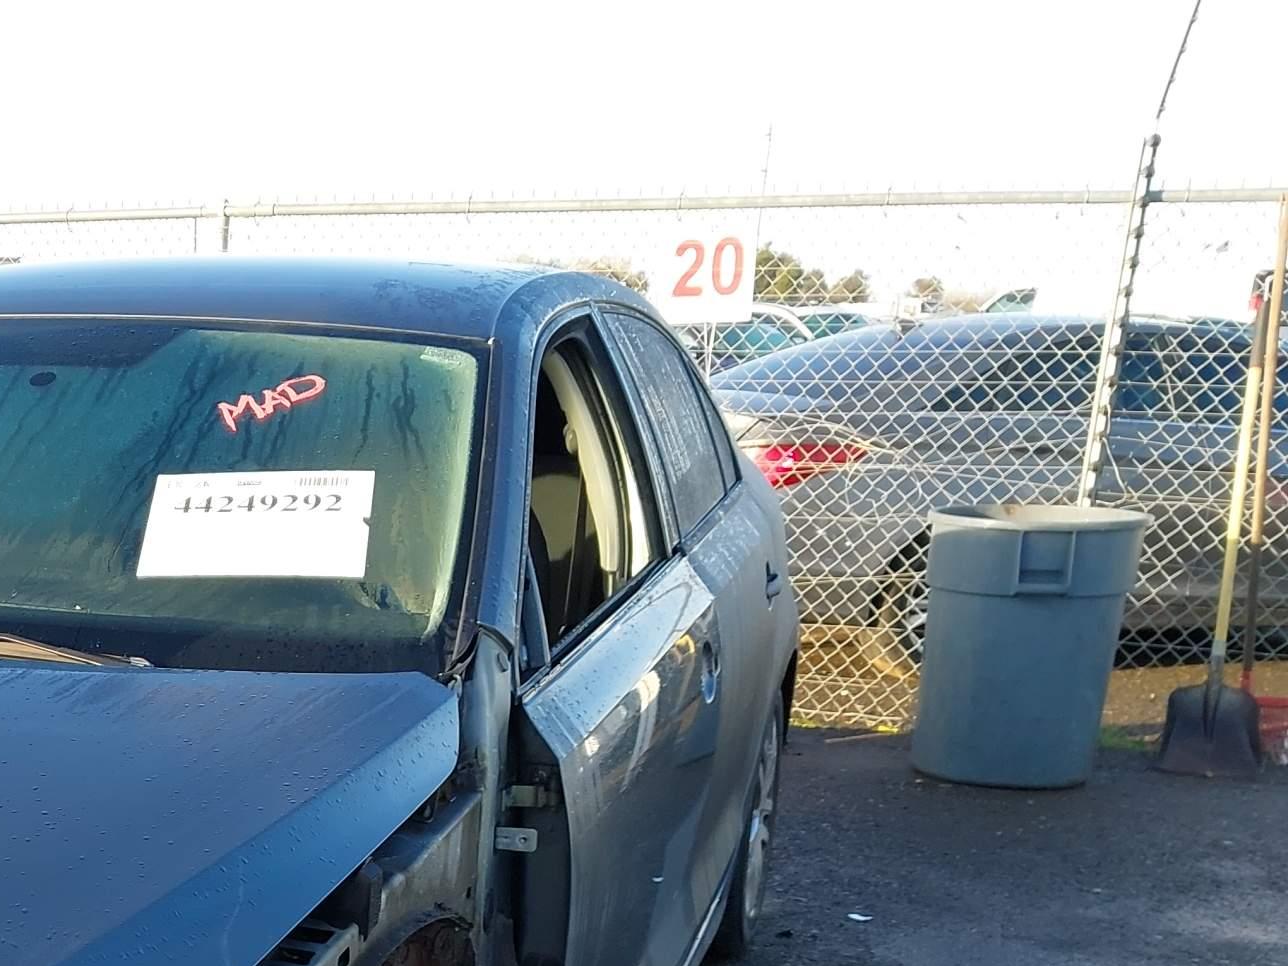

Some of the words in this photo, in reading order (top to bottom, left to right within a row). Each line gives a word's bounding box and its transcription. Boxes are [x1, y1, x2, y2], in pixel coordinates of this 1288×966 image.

[672, 236, 744, 297] 20
[217, 374, 326, 432] MAD
[174, 494, 342, 513] 44249292
